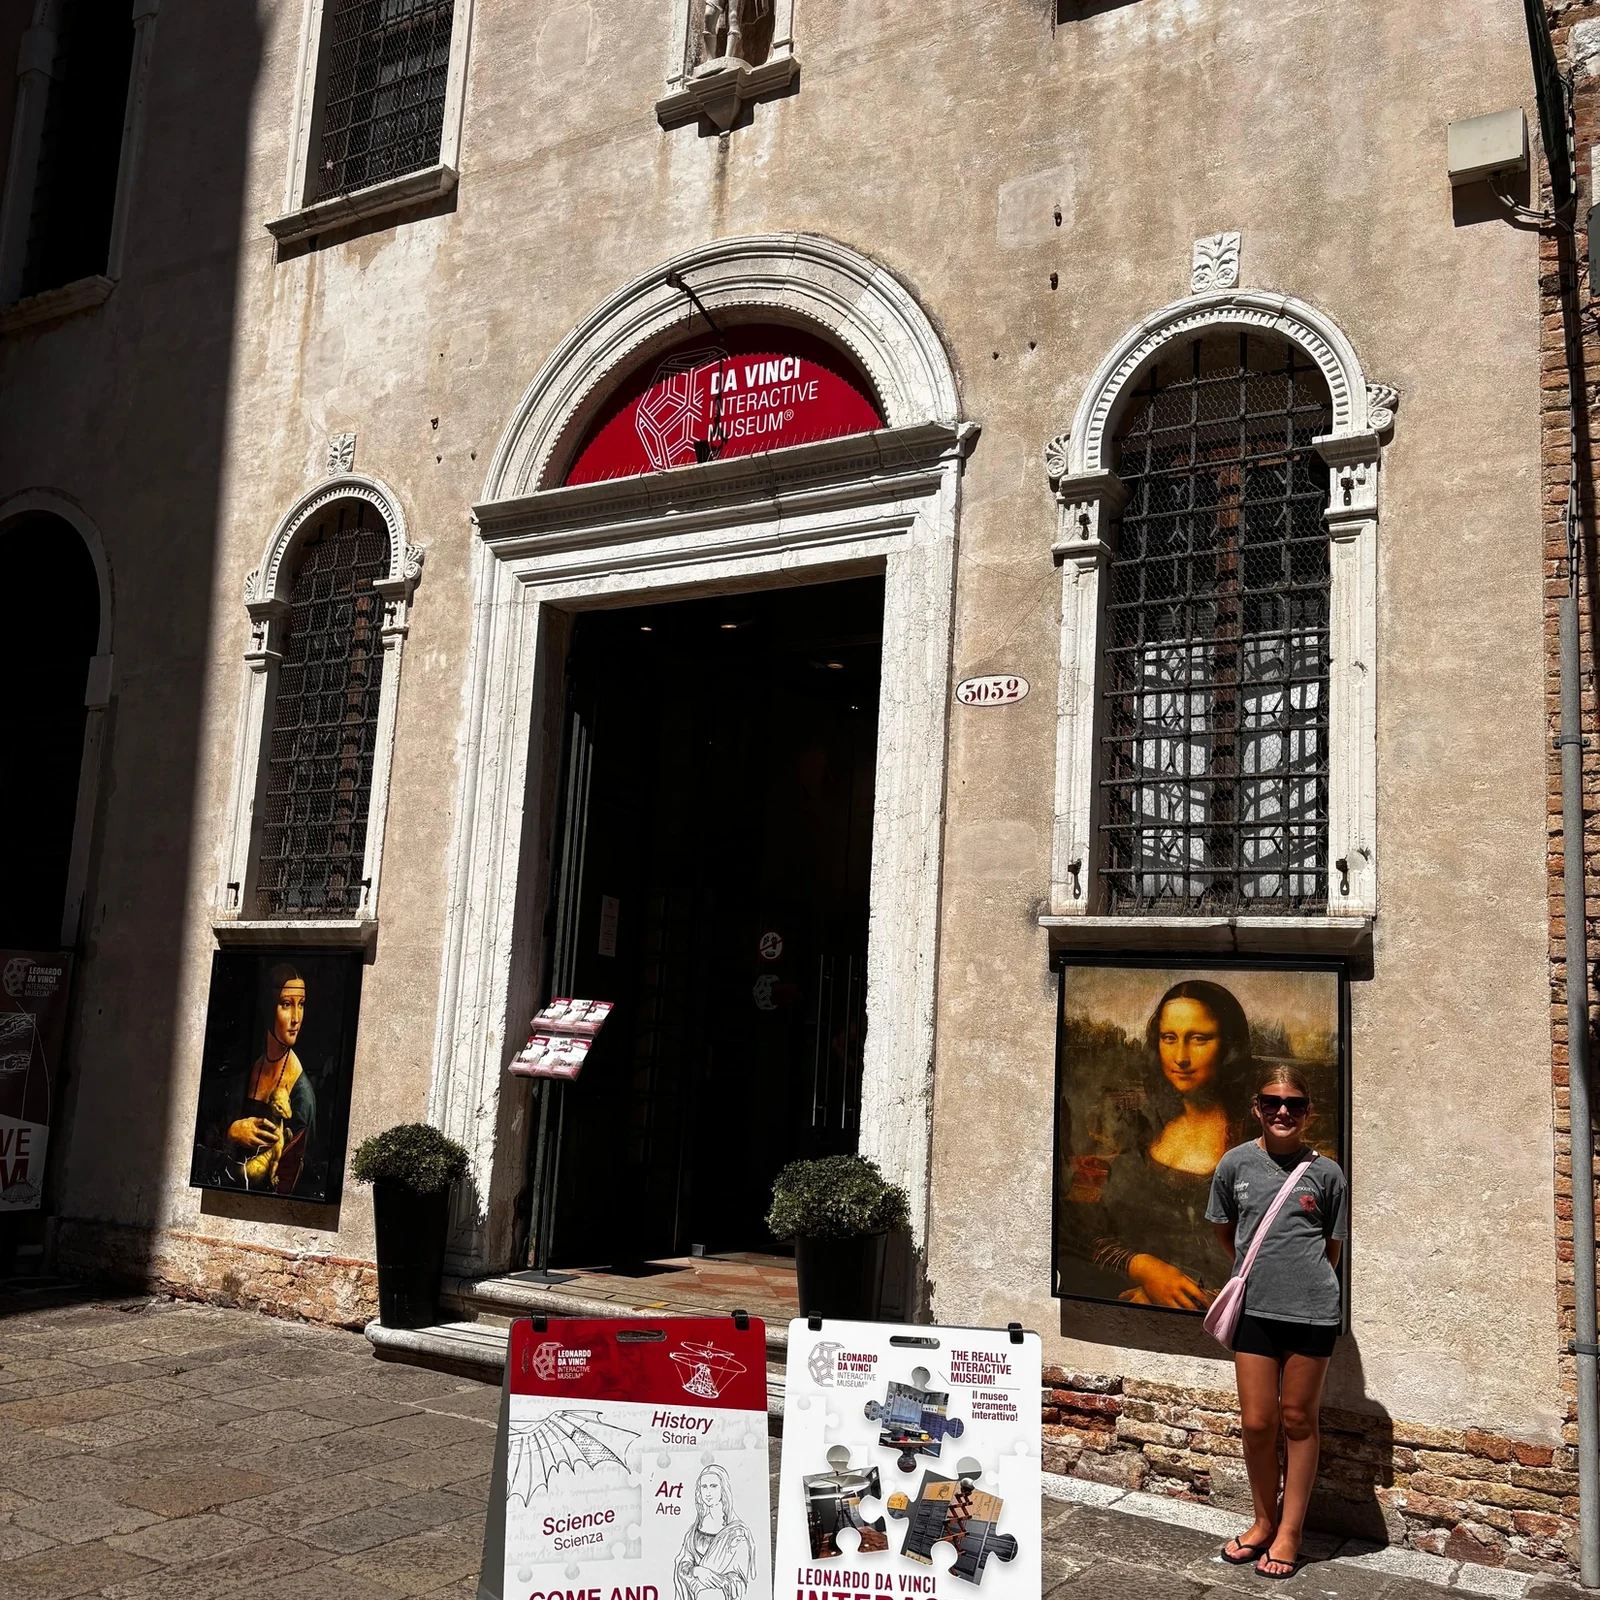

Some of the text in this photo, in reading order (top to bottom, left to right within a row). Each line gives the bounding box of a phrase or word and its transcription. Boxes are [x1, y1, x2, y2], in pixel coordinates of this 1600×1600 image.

[710, 356, 801, 395] DA VINCI
[709, 380, 819, 419] INTERACTIVE
[28, 966, 63, 977] LEONARDO
[557, 1349, 592, 1358] LEONARDO
[838, 1352, 878, 1363] LEONARDO
[951, 1350, 1007, 1364] THE REALLY
[557, 1357, 587, 1366] DA VINCI
[837, 1362, 872, 1373] DA VINCI
[950, 1361, 1012, 1375] INTERACTIVE
[557, 1365, 591, 1373] INTERACTIVE
[836, 1371, 877, 1382] INTERACTIVE
[950, 1372, 996, 1385] MUSEUM!
[972, 1390, 1009, 1402] Il museo
[971, 1401, 1017, 1412] veramente
[971, 1410, 1018, 1422] interattivo!
[651, 1411, 714, 1435] History
[662, 1431, 697, 1446] Storia
[655, 1480, 684, 1498] Art
[655, 1502, 681, 1516] Arte
[542, 1509, 616, 1537] Science
[553, 1530, 604, 1551] Scienza
[797, 1567, 936, 1594] LEONARDO DA VINCI
